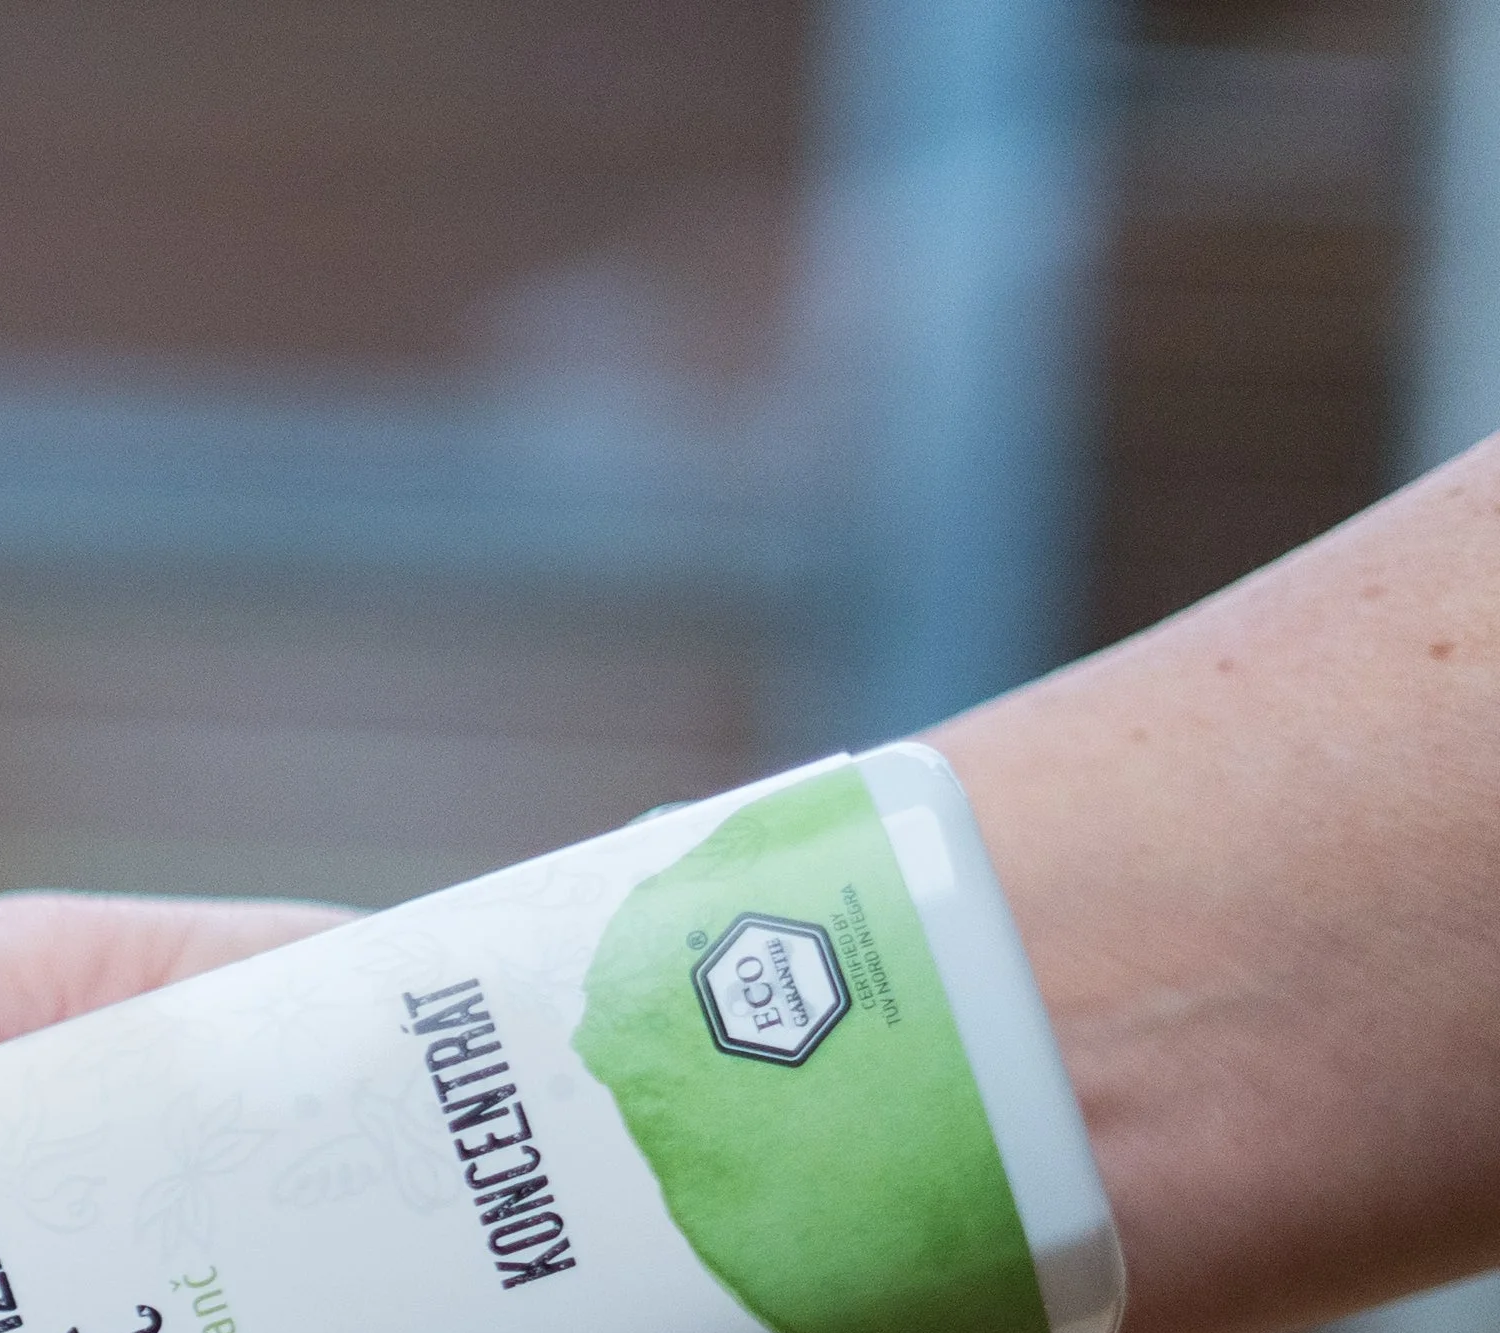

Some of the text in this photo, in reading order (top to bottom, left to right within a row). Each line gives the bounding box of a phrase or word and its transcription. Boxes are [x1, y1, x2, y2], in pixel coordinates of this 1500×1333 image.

[841, 884, 874, 948] INTEGRA
[736, 956, 783, 1032] ECO
[767, 937, 809, 1027] GARANTIE
[830, 912, 876, 1010] CERTIFIED BY
[864, 951, 891, 996] NORD
[400, 977, 577, 1291] KONCENTRÁT
